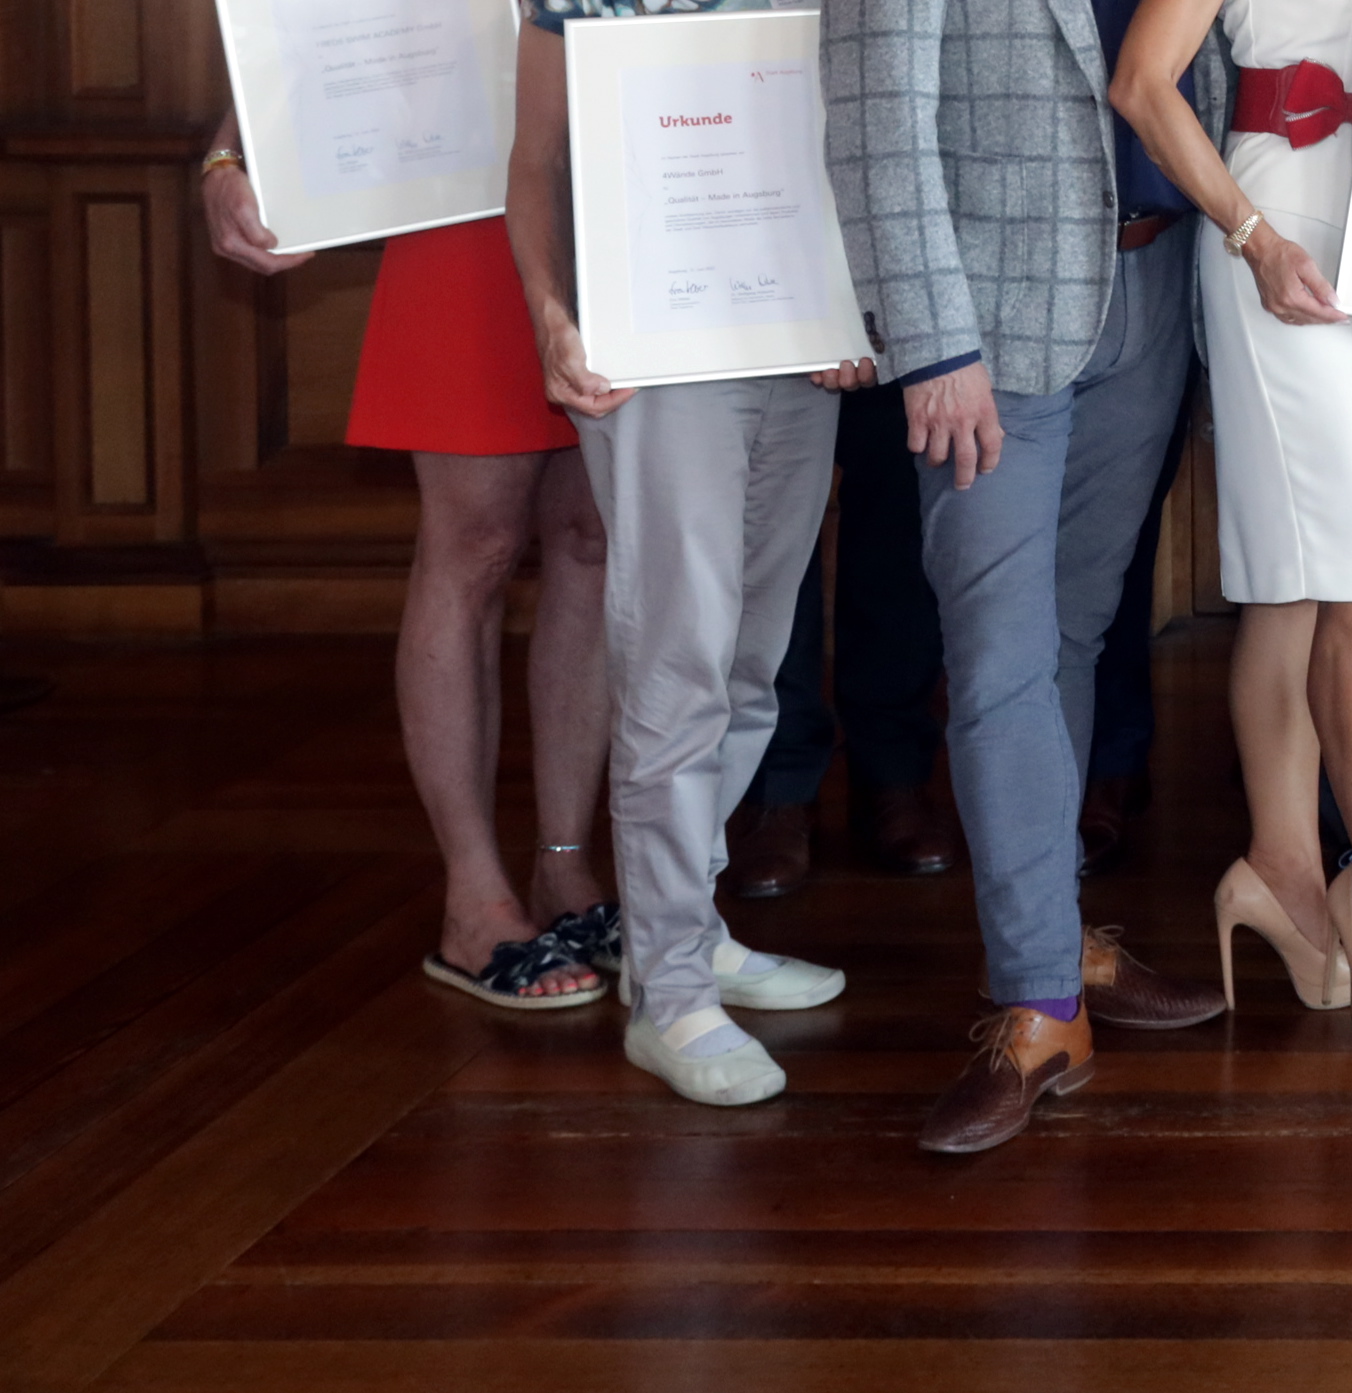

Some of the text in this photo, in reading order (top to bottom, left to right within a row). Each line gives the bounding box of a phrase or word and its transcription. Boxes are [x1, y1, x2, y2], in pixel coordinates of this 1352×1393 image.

[659, 113, 732, 128] Urkunde
[662, 169, 723, 179] 4Wände GmbH
